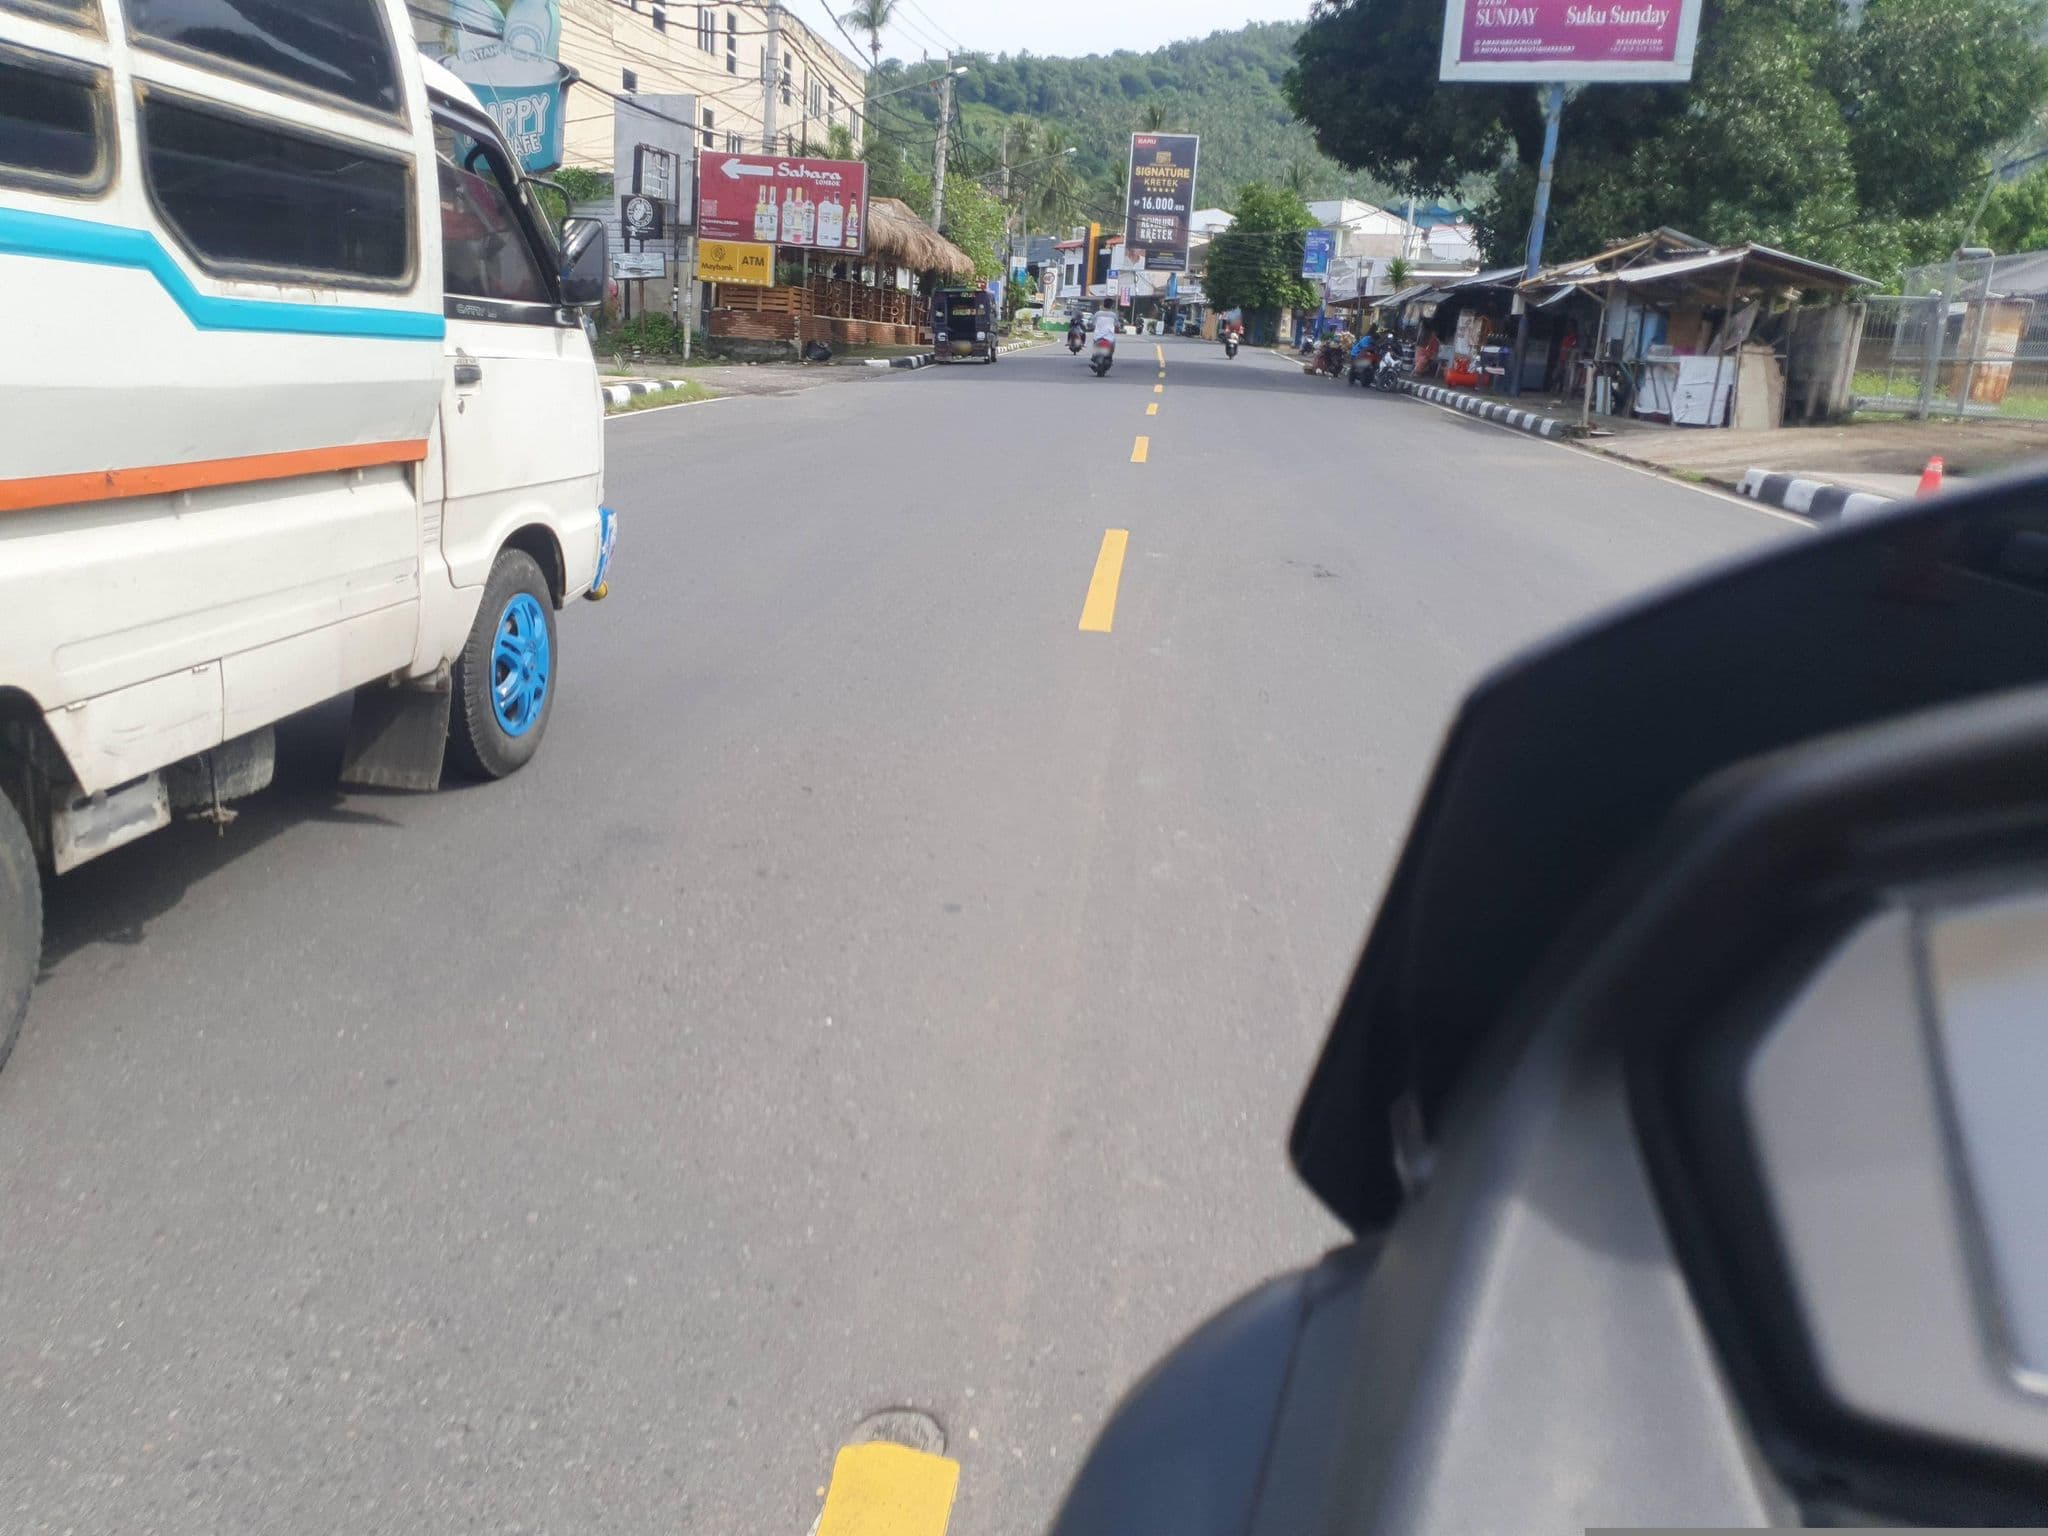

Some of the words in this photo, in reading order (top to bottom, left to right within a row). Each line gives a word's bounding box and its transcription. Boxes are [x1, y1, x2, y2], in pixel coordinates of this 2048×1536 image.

[1475, 7, 1539, 26] SUNDAY
[1565, 4, 1606, 26] Suku
[1609, 4, 1670, 31] Sunday
[484, 93, 550, 136] APPY
[777, 162, 842, 181] Sahara
[1135, 166, 1190, 179] SIGNATURE
[815, 179, 841, 187] LOMBOK
[1144, 177, 1178, 187] KRETEK
[1142, 197, 1174, 210] 16.000
[1140, 228, 1173, 240] KRETEK
[701, 262, 734, 272] Maybank
[741, 255, 765, 267] ATM
